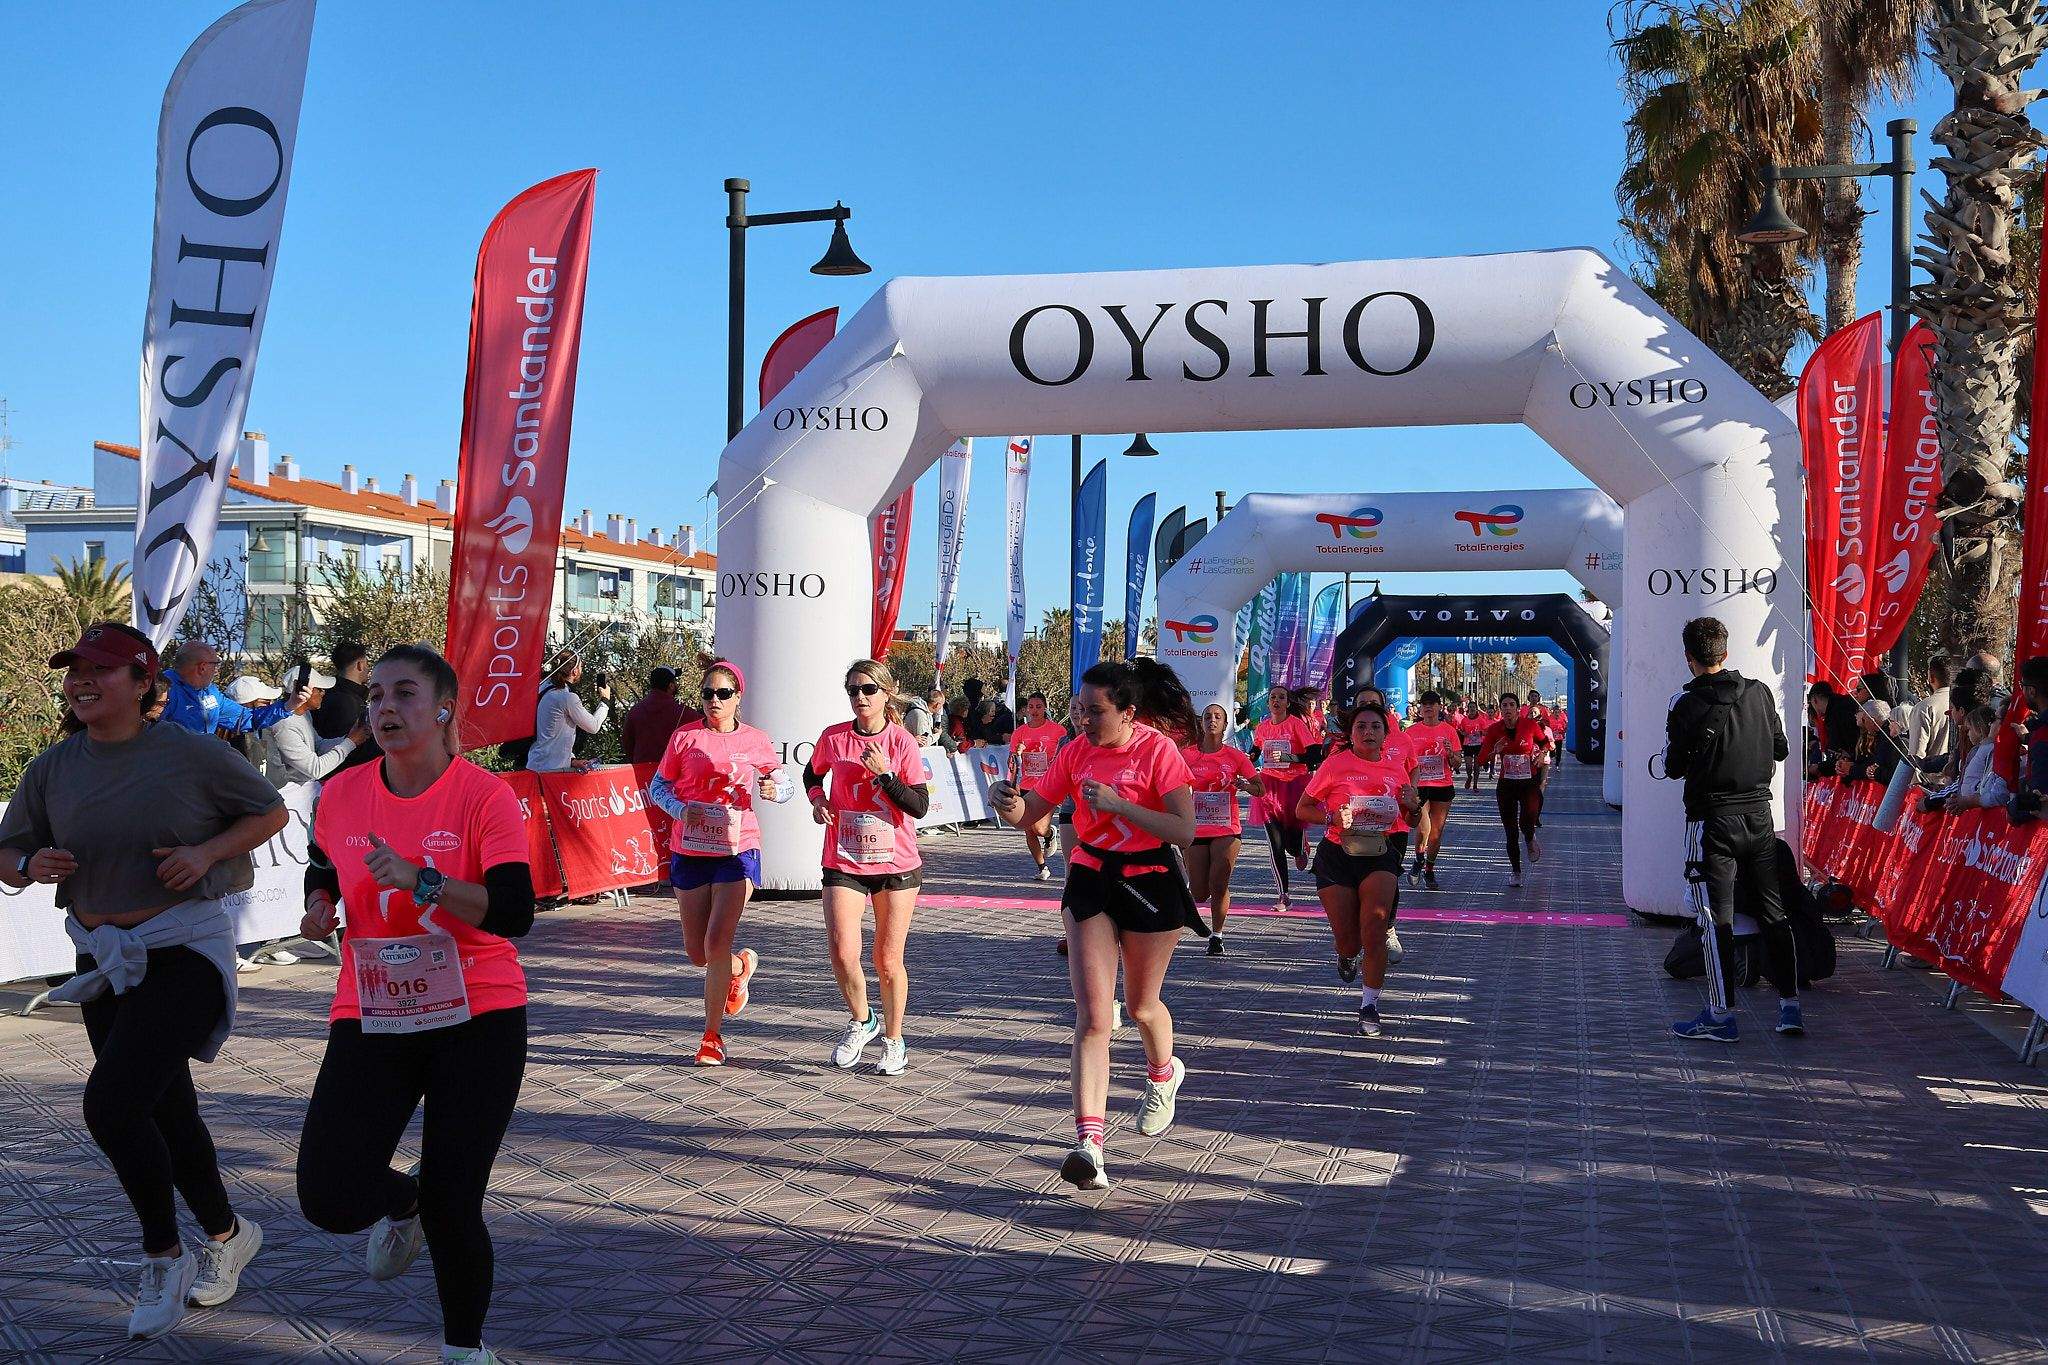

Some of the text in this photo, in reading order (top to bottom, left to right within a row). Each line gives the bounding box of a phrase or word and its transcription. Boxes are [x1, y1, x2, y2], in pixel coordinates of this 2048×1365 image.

[1008, 291, 1436, 386] OYSHO
[142, 106, 284, 626] OYSHO
[1569, 378, 1708, 409] OYSHO
[773, 406, 889, 431] OYSHO
[476, 247, 558, 706] Sports Santander
[1829, 380, 1864, 557] Santander
[1893, 390, 1942, 543] Santand
[1316, 545, 1384, 555] TotalEnergies
[1454, 543, 1525, 553] TotalEnergies
[721, 572, 826, 598] OYSHO
[1648, 567, 1778, 596] OYSHO
[1407, 609, 1536, 621] VOLVO
[1164, 648, 1218, 659] TotalEnergies
[1590, 659, 1599, 751] VOLVO
[561, 791, 610, 828] Sports
[703, 825, 723, 835] 016
[855, 834, 877, 843] 016
[425, 839, 458, 847] ASTURIANA
[381, 951, 418, 961] ASTURIANA
[387, 977, 429, 997] 016
[371, 1008, 391, 1016] CARRERA
[428, 1002, 453, 1011] VALENCIA
[397, 999, 418, 1008] 3922
[371, 1013, 457, 1029] OYSHO Santander
